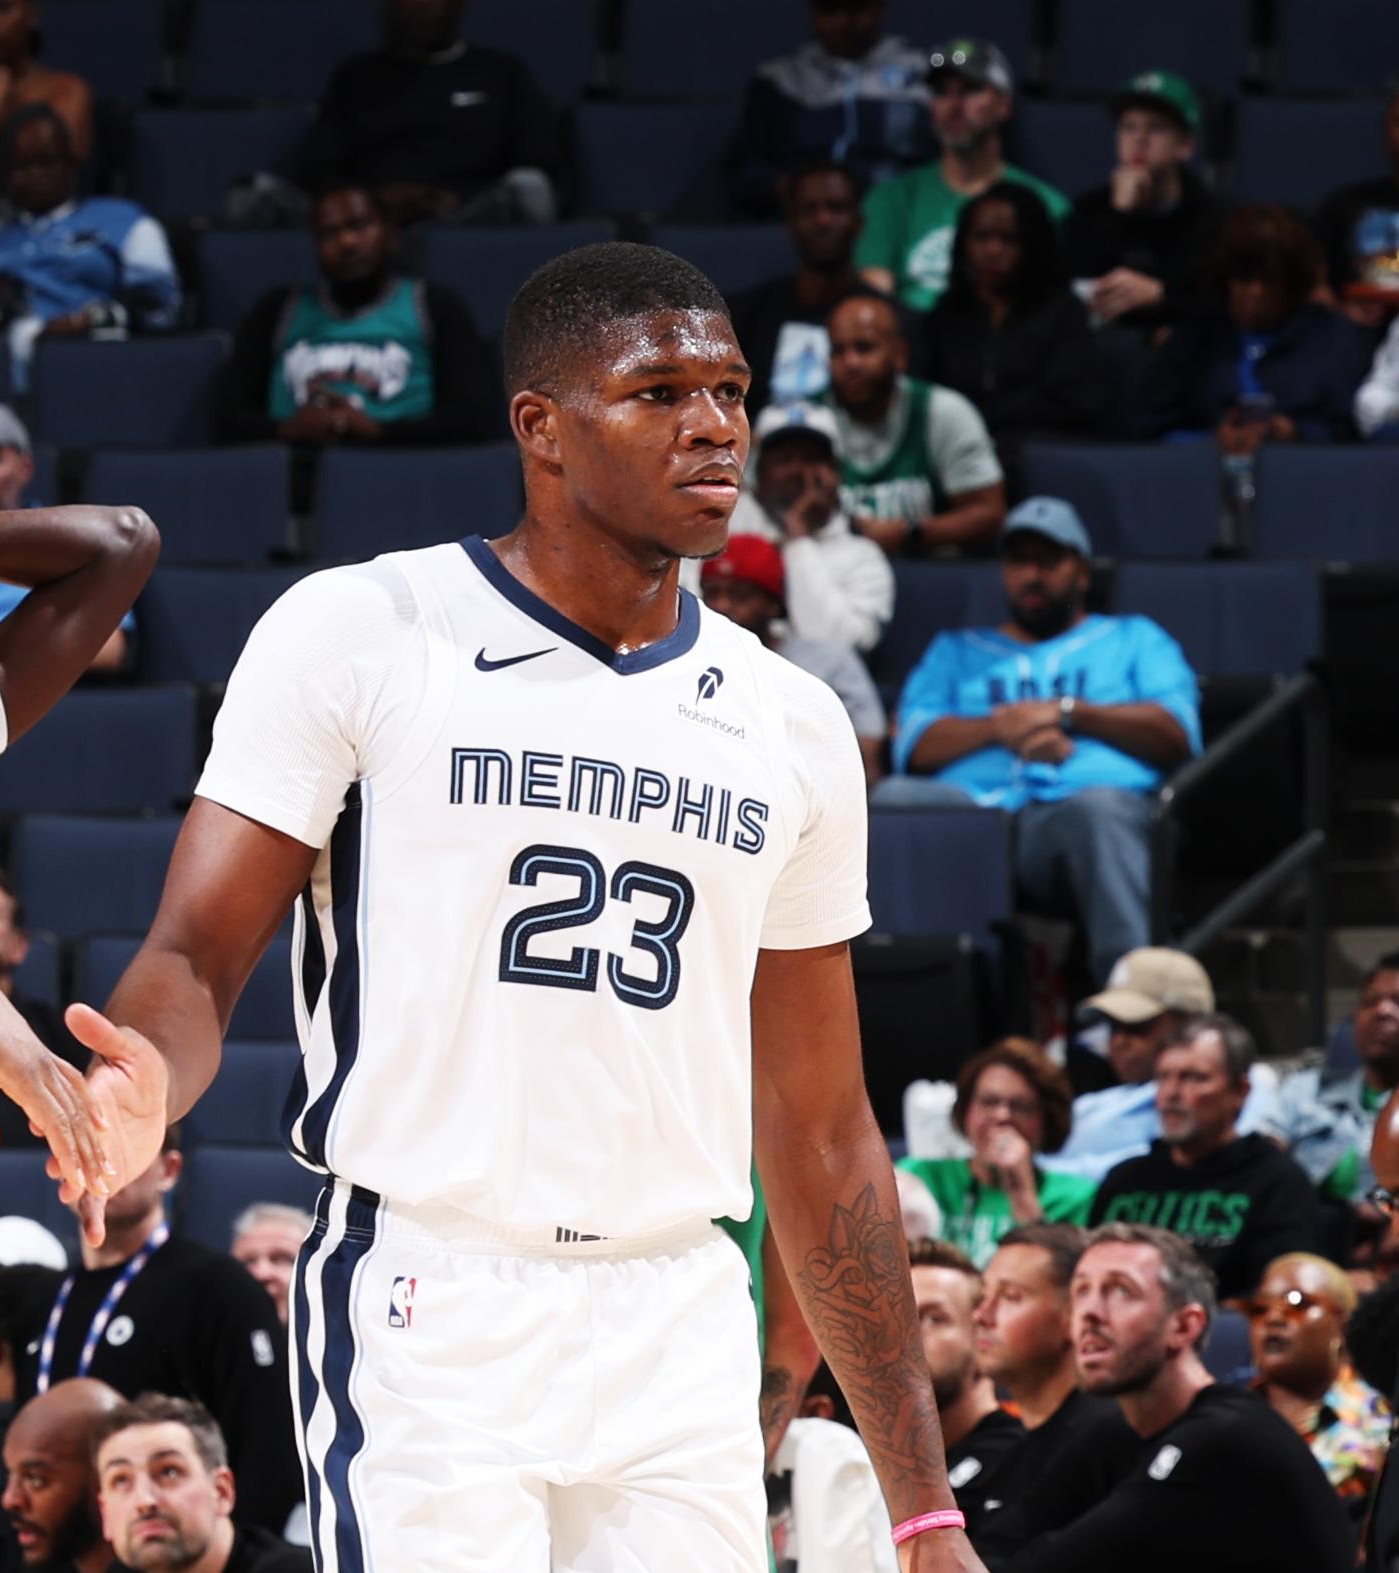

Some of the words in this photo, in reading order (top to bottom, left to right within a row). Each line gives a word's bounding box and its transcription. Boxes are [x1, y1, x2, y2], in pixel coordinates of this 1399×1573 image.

[678, 703, 745, 740] Robinhood
[449, 747, 770, 855] MEMPHIS
[498, 844, 695, 1010] 23
